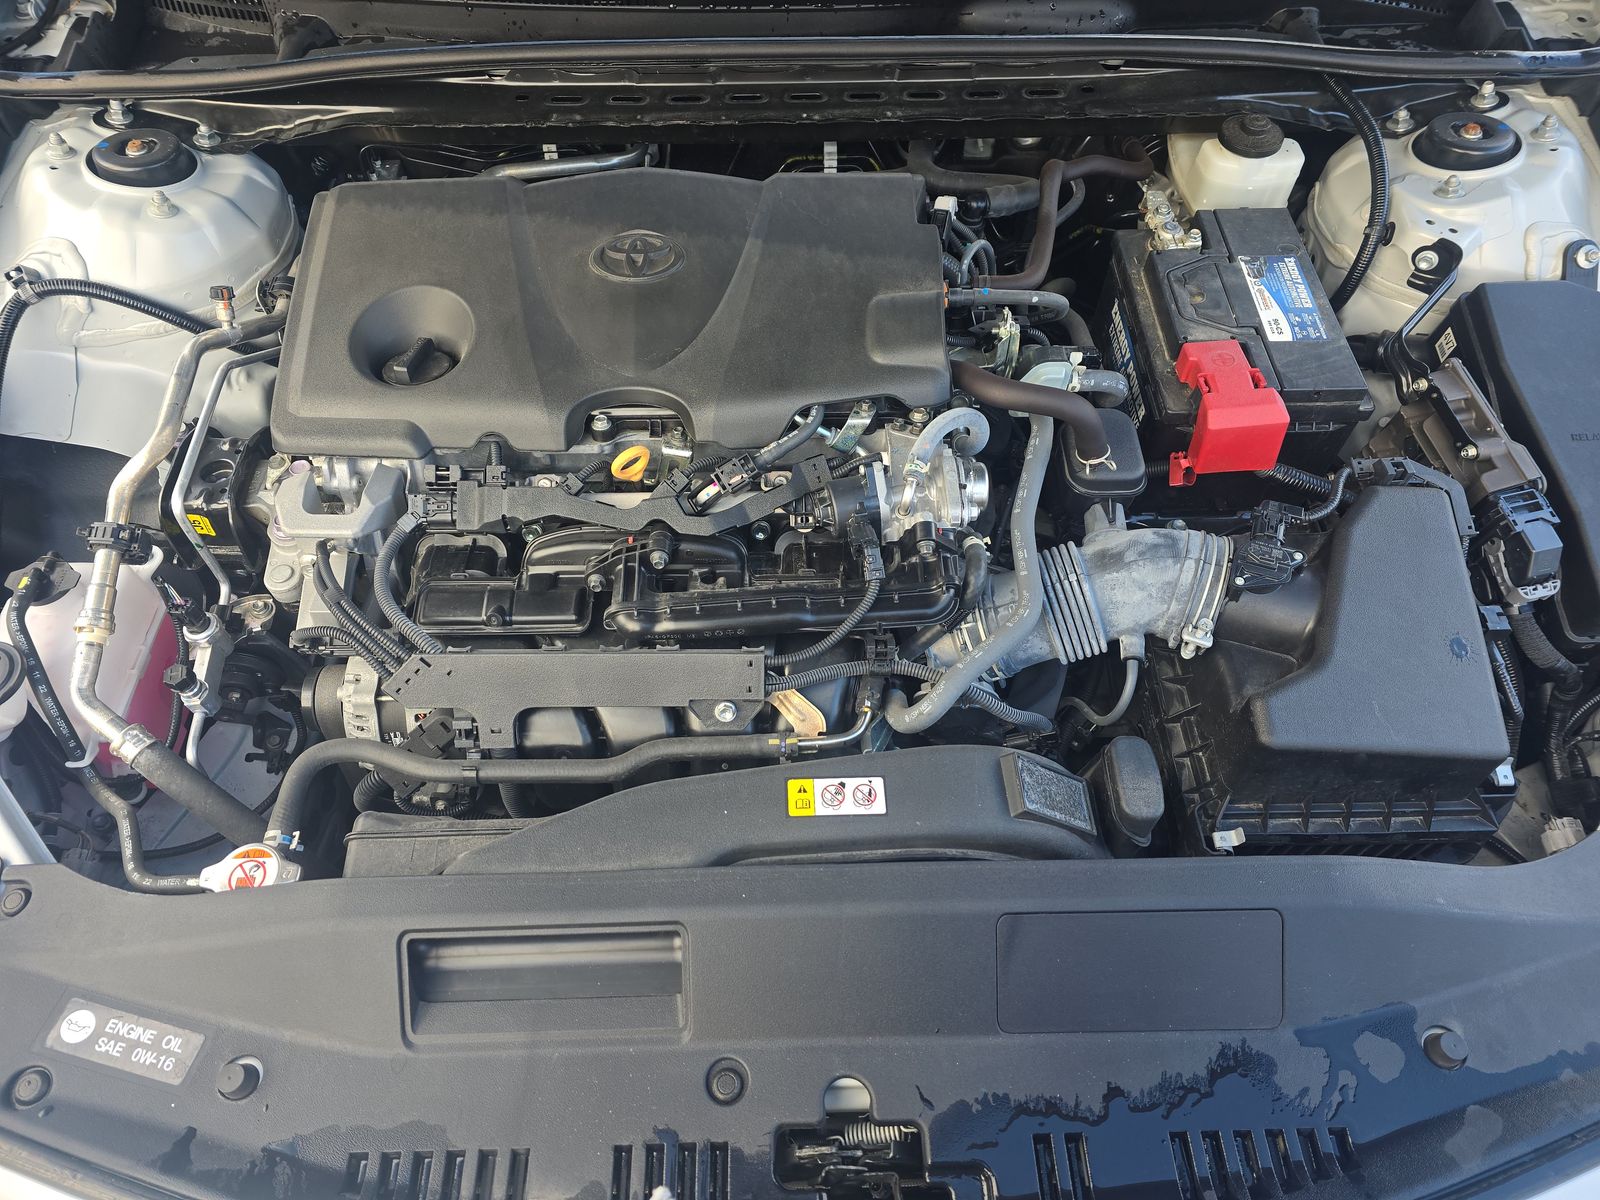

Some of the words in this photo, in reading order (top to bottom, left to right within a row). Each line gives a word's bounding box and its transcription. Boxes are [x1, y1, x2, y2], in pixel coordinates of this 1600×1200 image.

[1295, 283, 1313, 308] POWER
[1112, 298, 1131, 363] ENERGY
[1127, 360, 1146, 422] POWER
[1570, 432, 1600, 442] RELA
[10, 611, 20, 632] WATER
[38, 684, 48, 694] 22
[44, 696, 60, 718] WATER
[142, 878, 153, 886] 22
[104, 1018, 157, 1045] ENGINE
[161, 1034, 183, 1053] OIL
[94, 1037, 126, 1057] SAE
[131, 1047, 175, 1071] 0W-16
